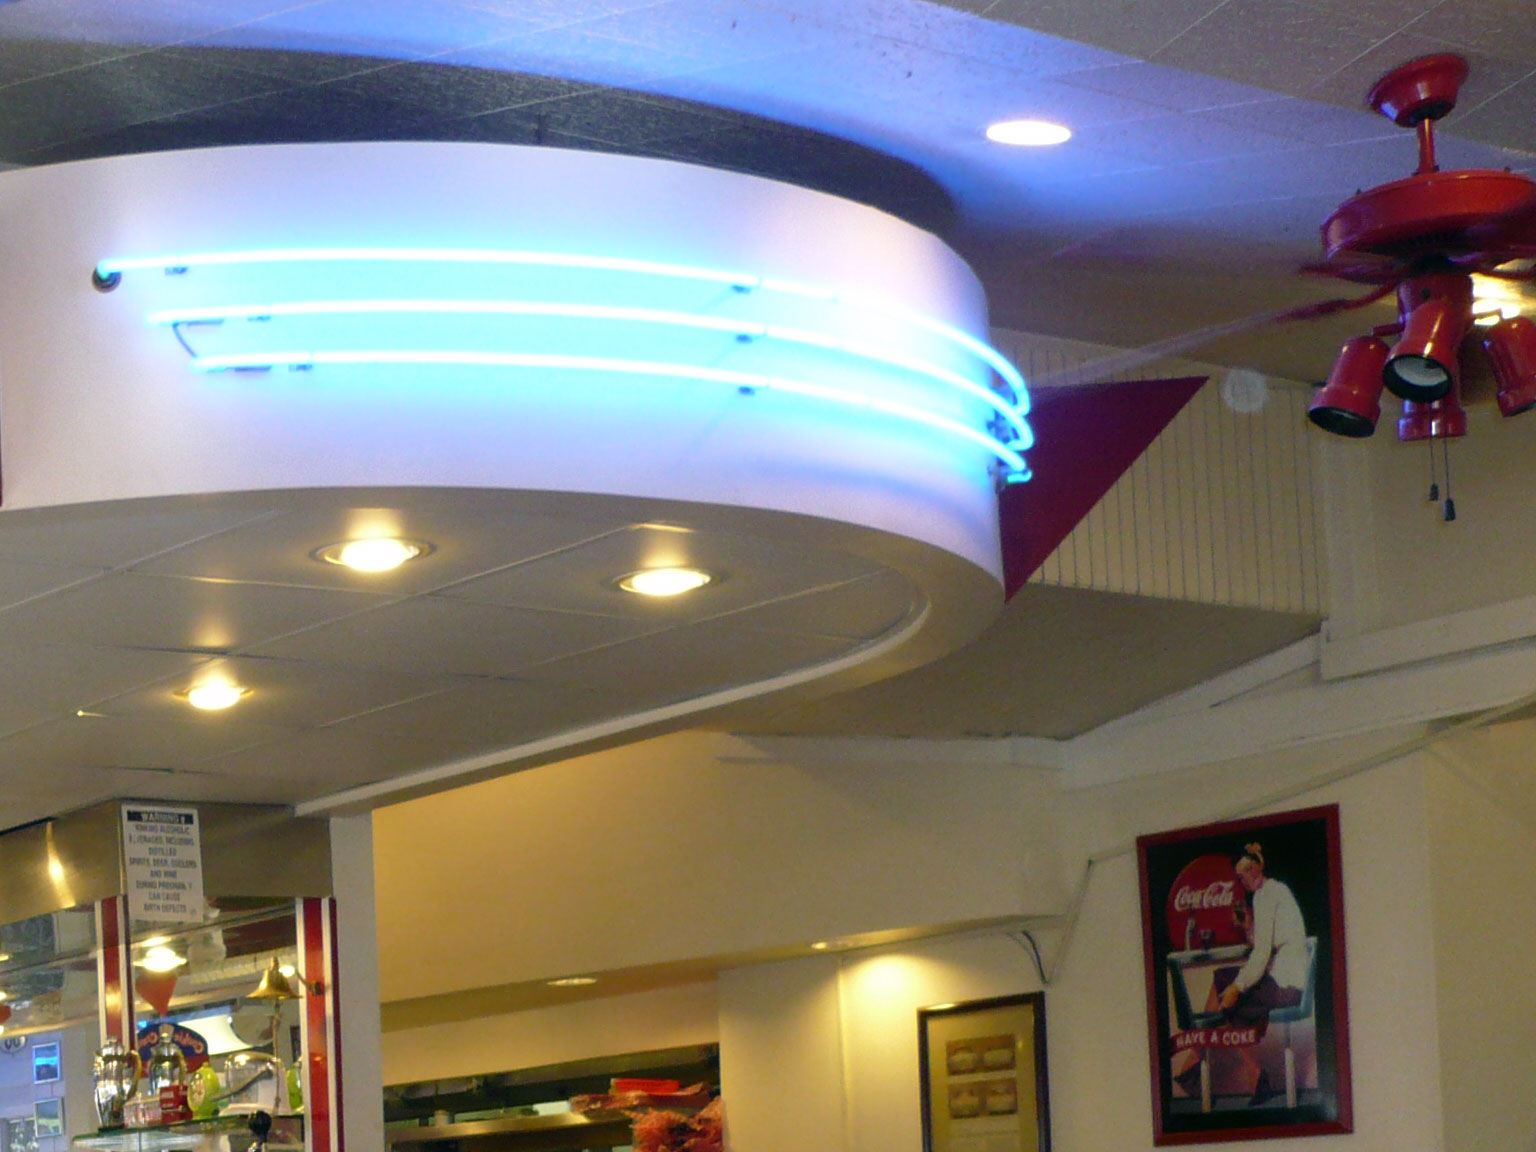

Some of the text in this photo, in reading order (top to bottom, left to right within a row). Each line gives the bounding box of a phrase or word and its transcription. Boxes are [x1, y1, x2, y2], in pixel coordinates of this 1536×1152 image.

[1176, 1028, 1255, 1048] HAVE A COKE
